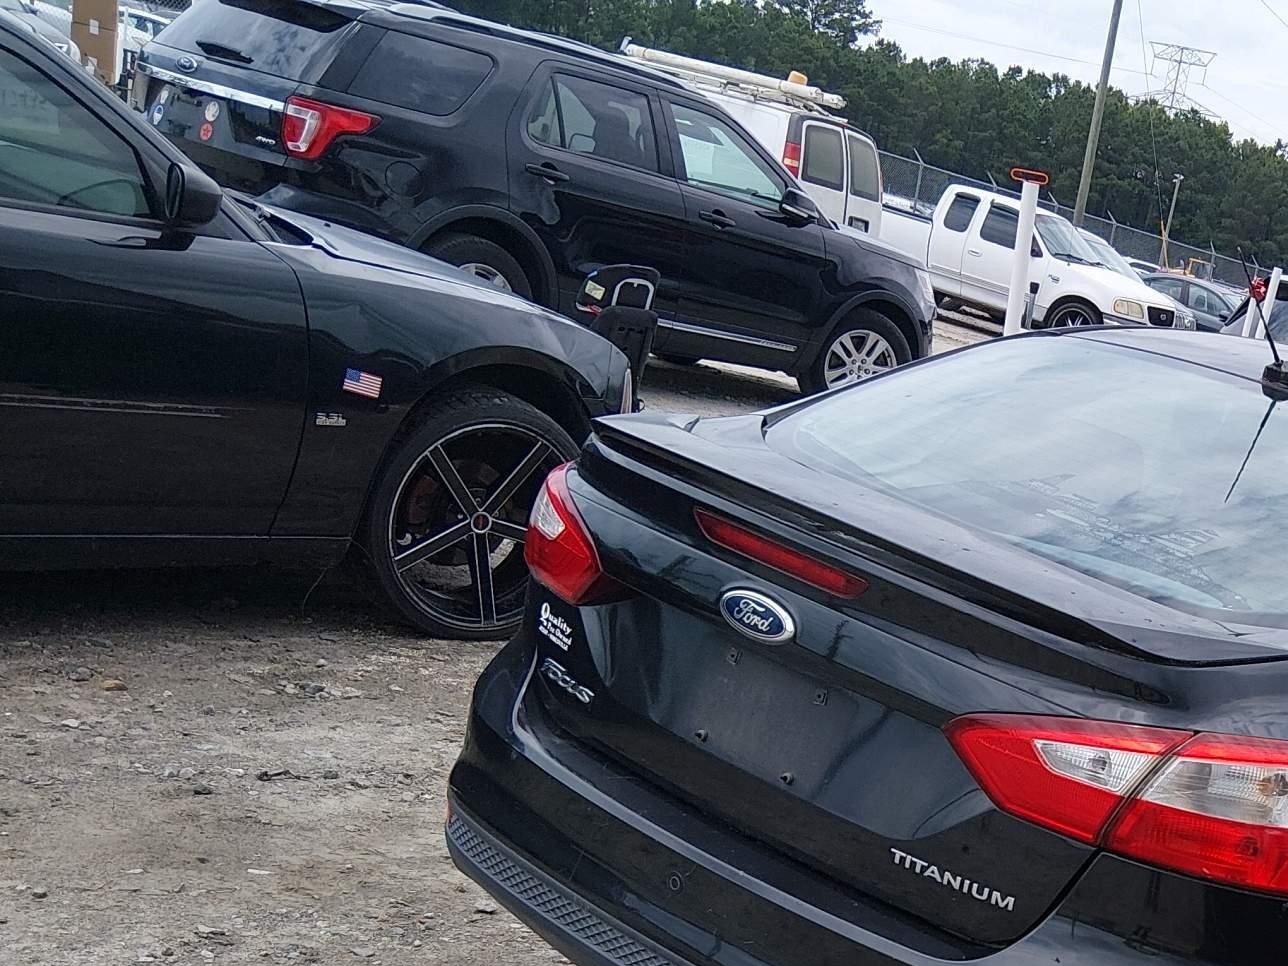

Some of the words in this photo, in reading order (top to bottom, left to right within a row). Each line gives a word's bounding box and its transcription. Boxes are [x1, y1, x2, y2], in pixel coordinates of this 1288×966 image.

[540, 602, 572, 635] Quality
[733, 599, 773, 631] Ford
[890, 847, 1015, 911] TITANIUM
